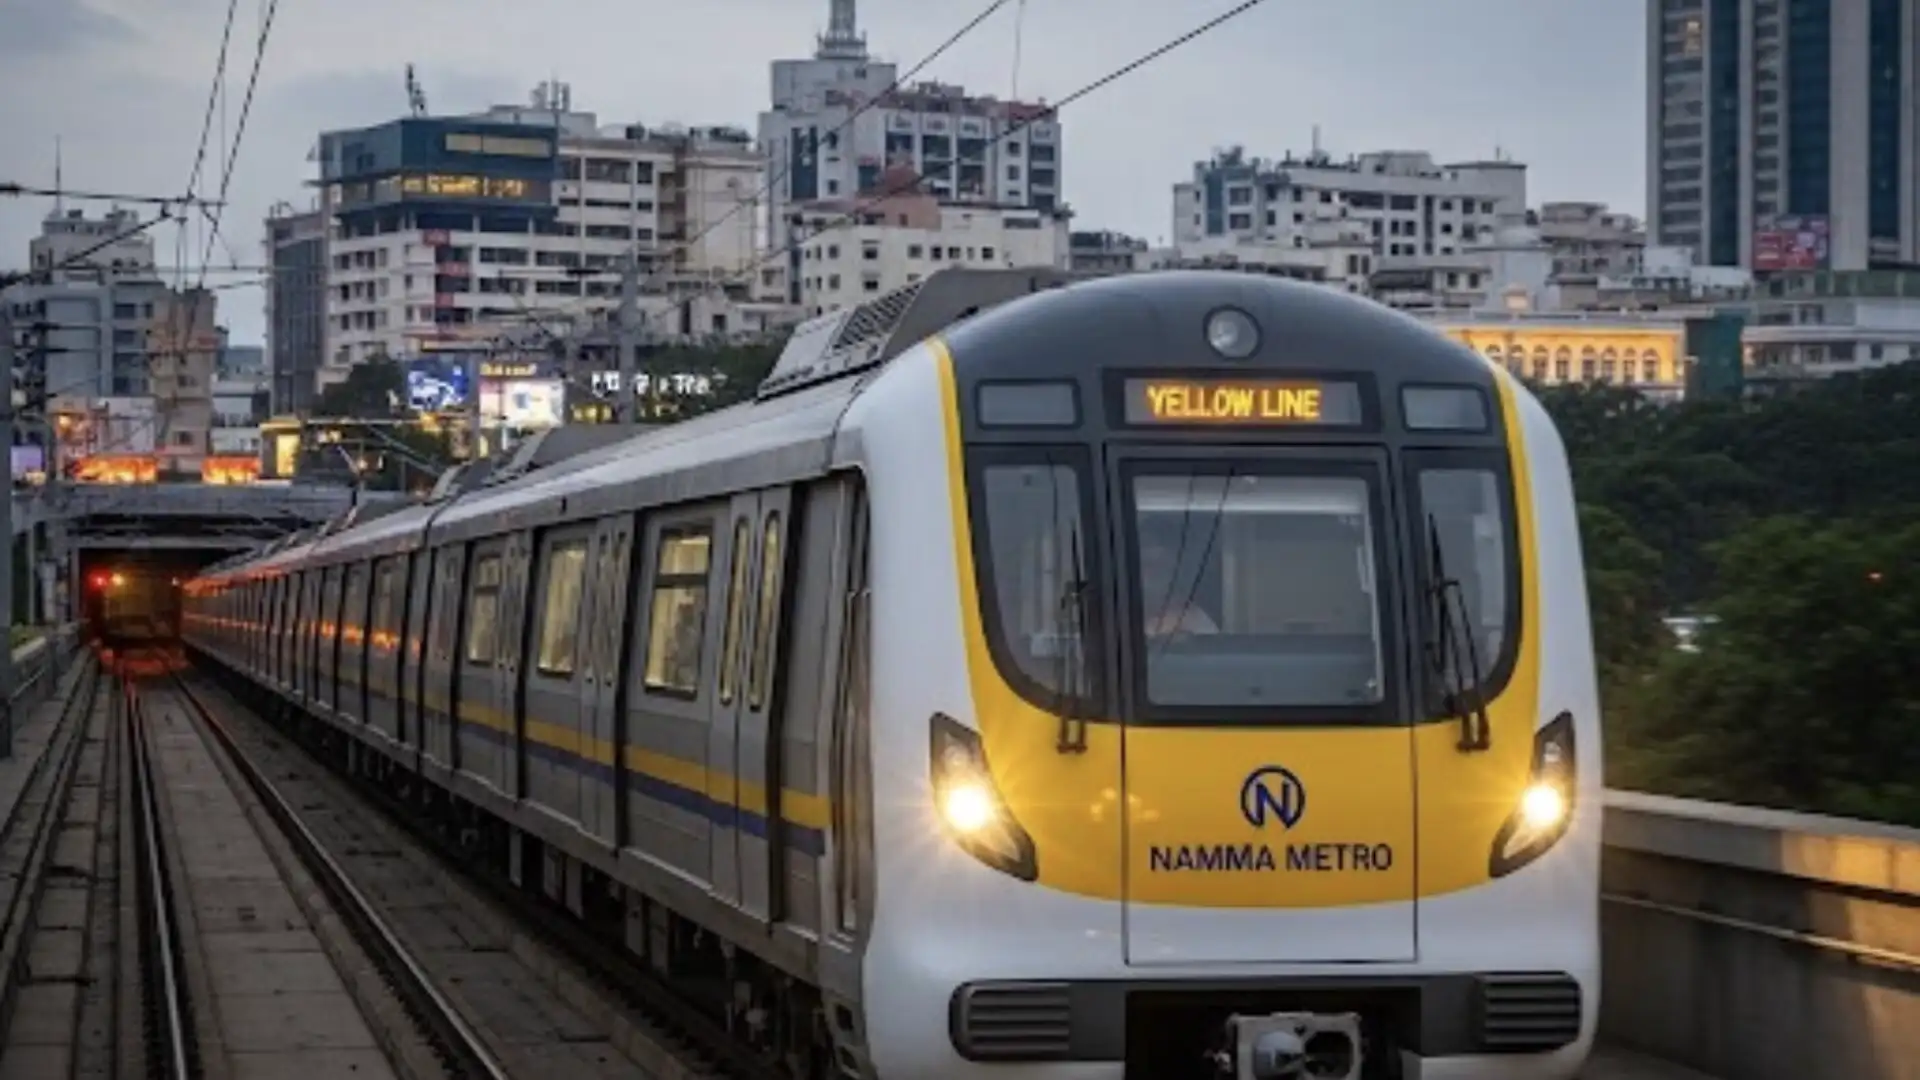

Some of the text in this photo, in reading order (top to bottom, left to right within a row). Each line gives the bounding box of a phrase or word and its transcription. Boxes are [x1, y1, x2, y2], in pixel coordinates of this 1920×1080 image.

[1147, 384, 1320, 418] YELLOW LINE
[1150, 843, 1393, 872] NAMMA METRO
